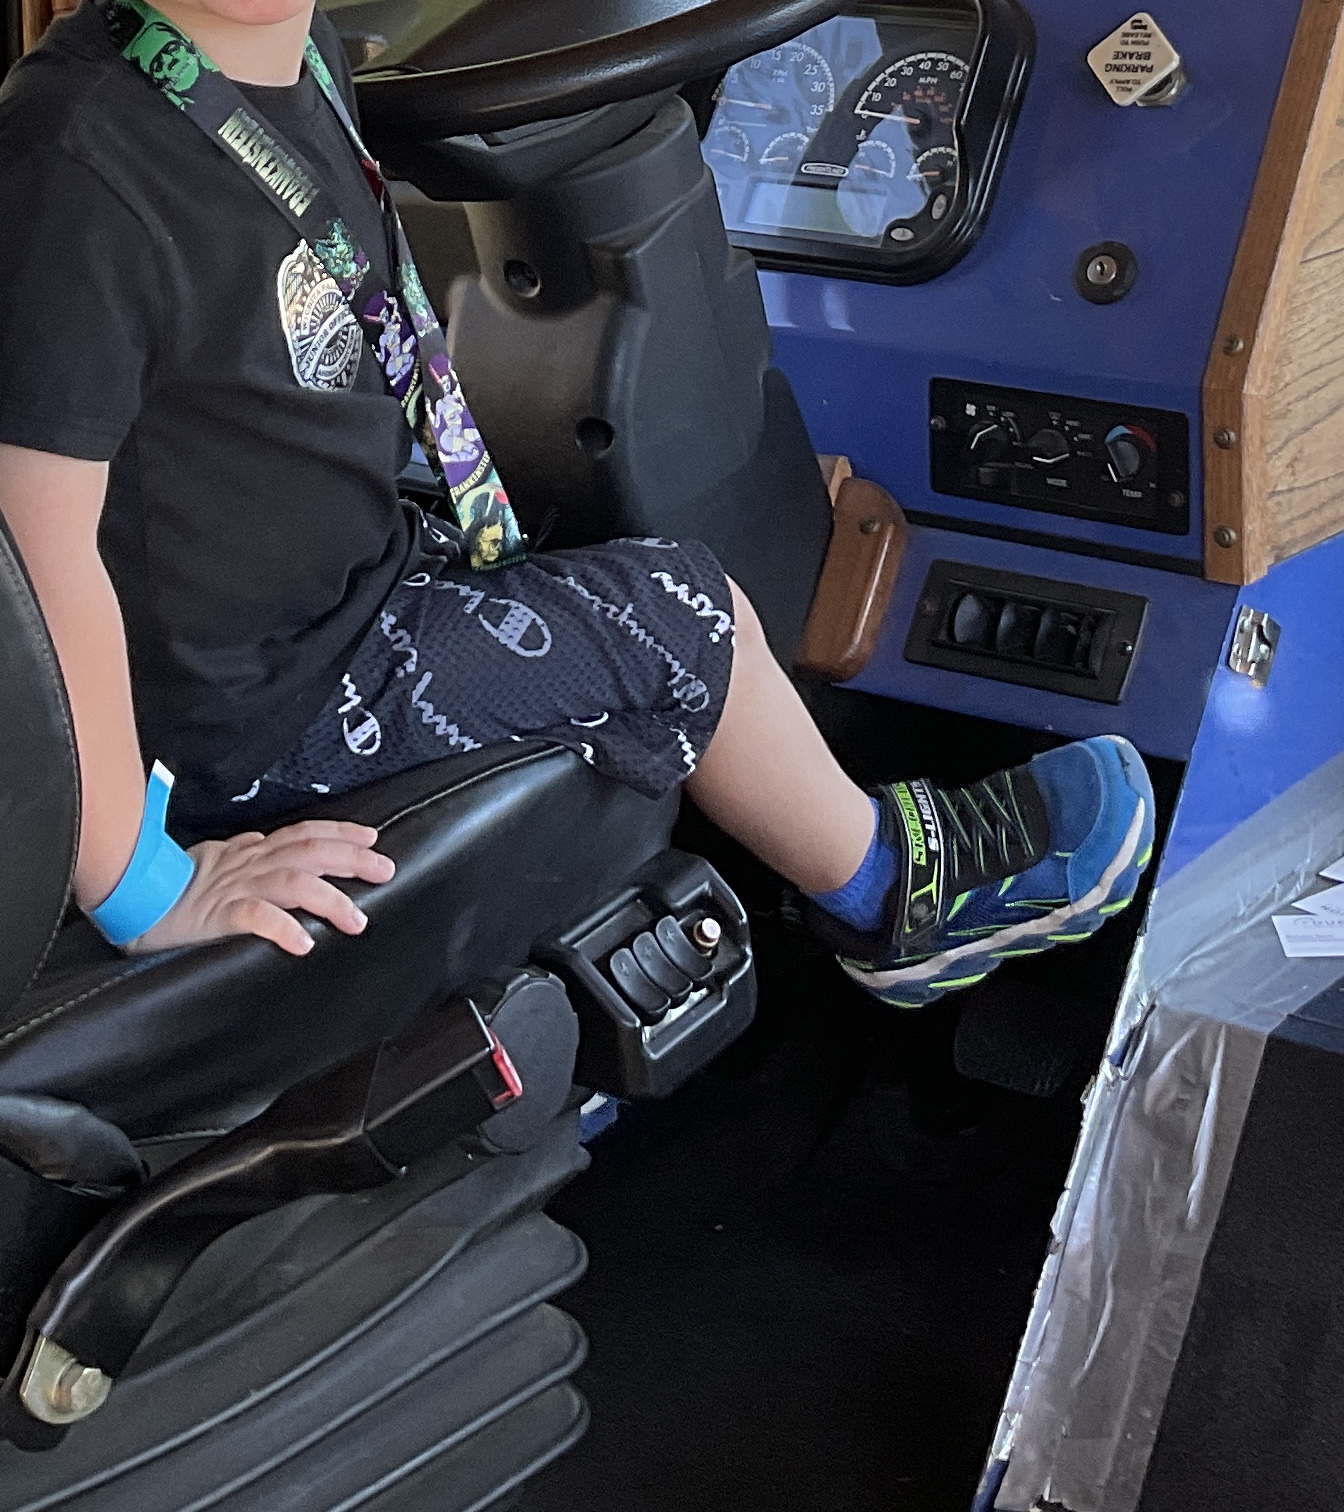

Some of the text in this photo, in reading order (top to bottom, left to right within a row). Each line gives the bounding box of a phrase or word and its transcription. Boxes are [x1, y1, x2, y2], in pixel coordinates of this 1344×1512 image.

[771, 50, 782, 61] 15
[790, 51, 804, 62] 20
[1112, 51, 1152, 60] BRAKE
[749, 59, 761, 69] 10
[803, 63, 818, 76] 25
[1104, 63, 1154, 73] PARKING
[871, 91, 882, 102] 10
[884, 77, 897, 87] 20
[900, 66, 914, 76] 30
[918, 60, 932, 70] 40
[936, 61, 950, 71] 50
[949, 70, 964, 80] 60
[918, 76, 938, 85] MPH
[810, 81, 826, 93] 30
[809, 104, 825, 116] 35
[217, 107, 320, 218] FRANKENSTEIN
